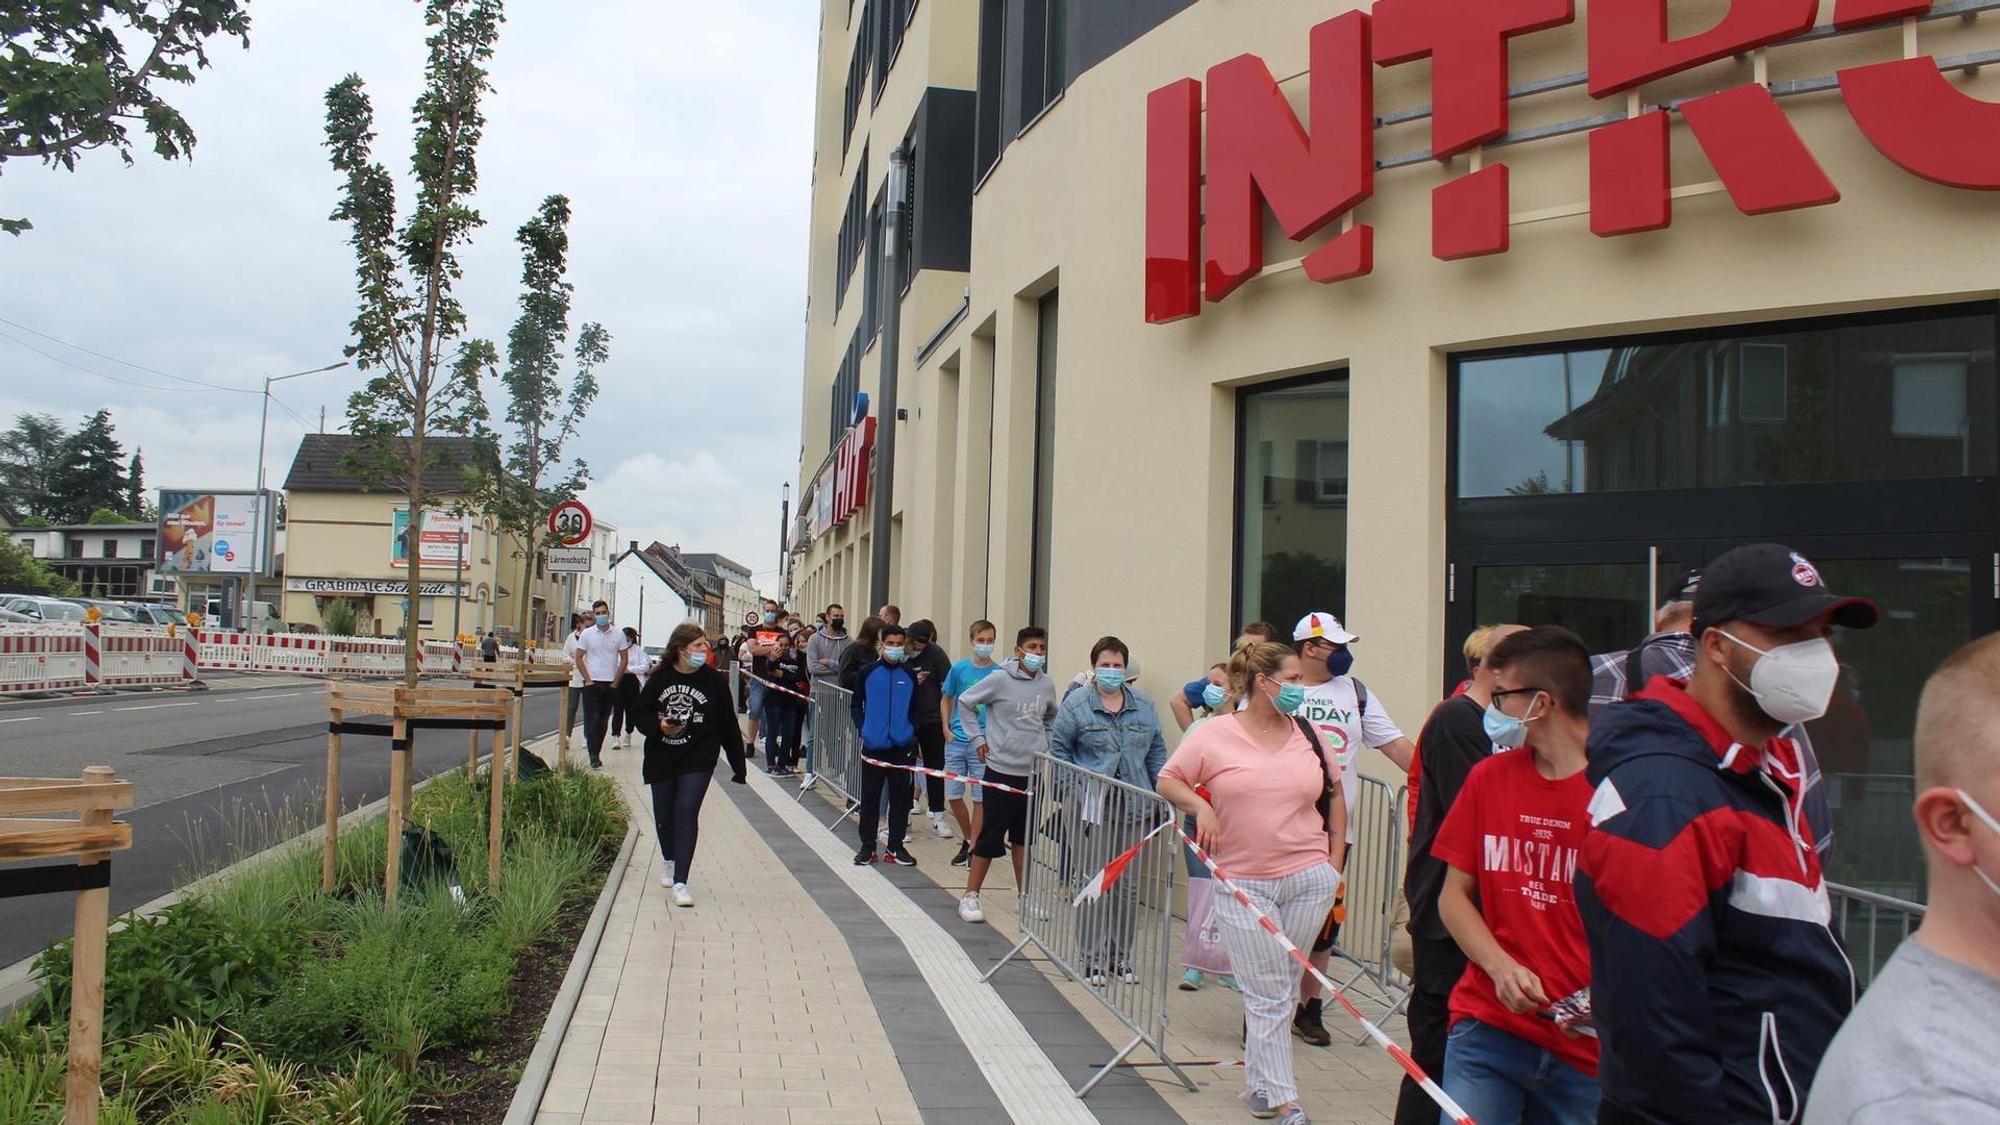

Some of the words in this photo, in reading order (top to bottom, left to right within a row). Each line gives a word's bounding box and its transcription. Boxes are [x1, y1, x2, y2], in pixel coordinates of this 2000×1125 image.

[559, 513, 583, 535] 30
[550, 556, 587, 564] Lärmschutz
[305, 579, 383, 593] GRABMALE
[1303, 698, 1334, 706] MMER
[1306, 706, 1351, 723] IDAY
[1519, 814, 1542, 825] TRUE
[1543, 818, 1571, 829] DENIM
[1484, 834, 1578, 884] MUSTAN
[1520, 887, 1558, 903] TRADE
[1198, 930, 1221, 943] ALD
